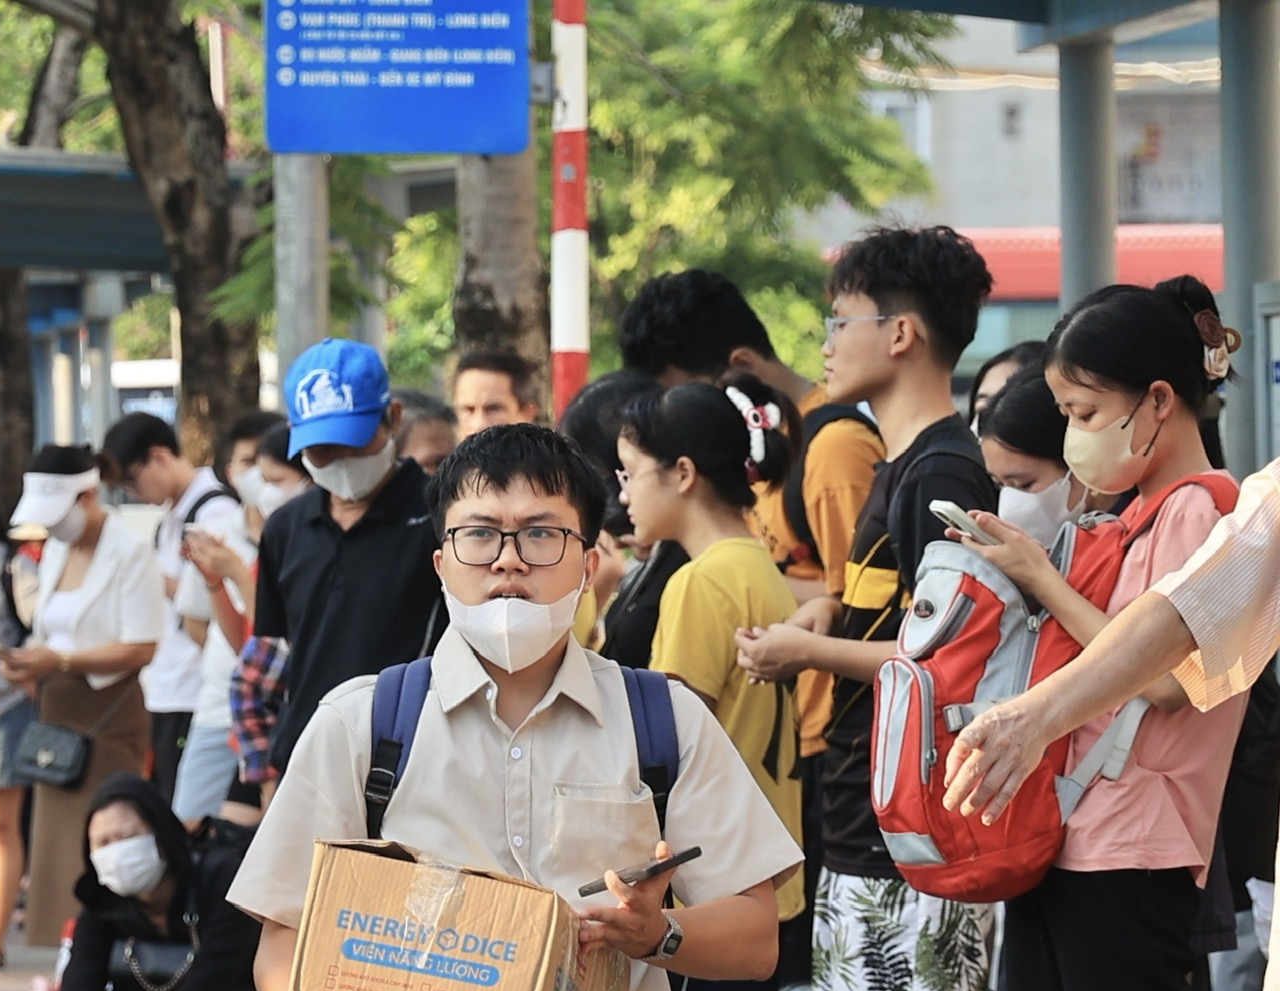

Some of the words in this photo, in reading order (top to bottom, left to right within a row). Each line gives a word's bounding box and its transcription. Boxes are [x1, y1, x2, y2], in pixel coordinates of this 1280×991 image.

[337, 909, 435, 945] ENERGY
[461, 934, 518, 963] DICE
[352, 942, 385, 960] VIÊN
[437, 961, 490, 982] LƯỢNG
